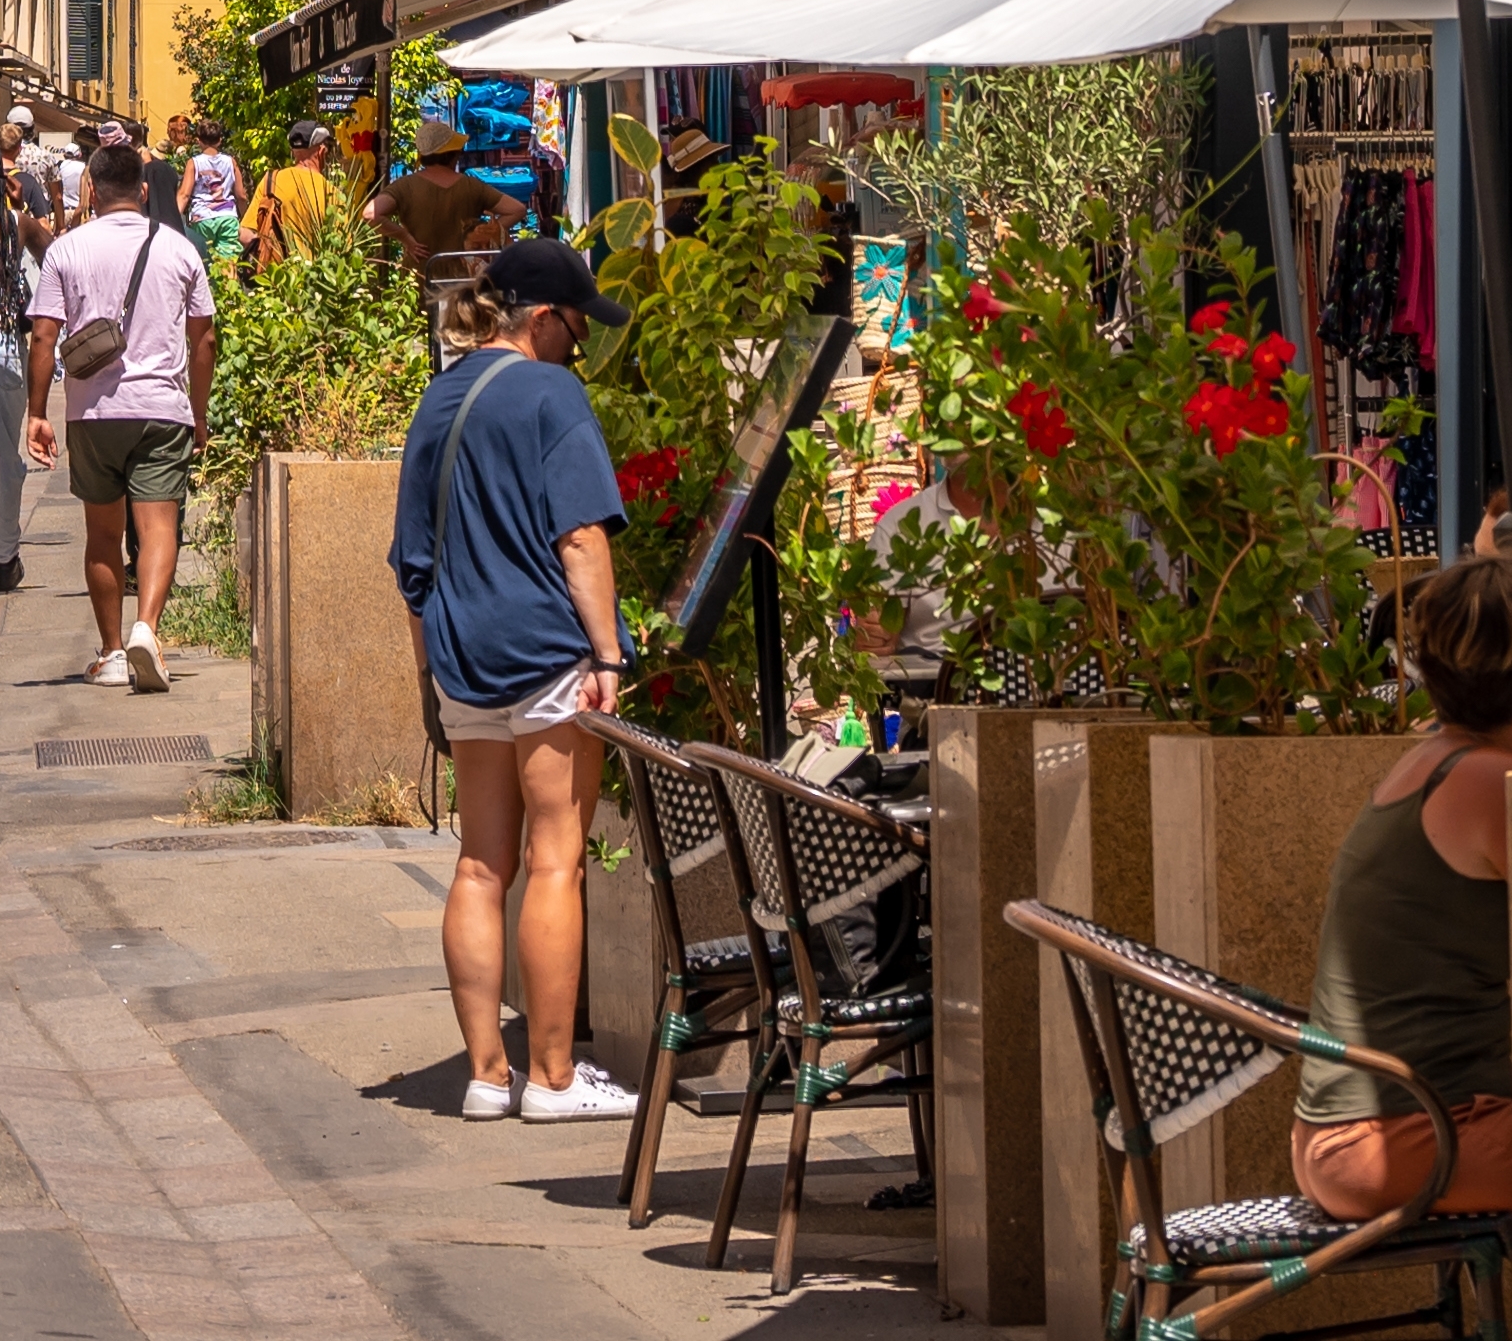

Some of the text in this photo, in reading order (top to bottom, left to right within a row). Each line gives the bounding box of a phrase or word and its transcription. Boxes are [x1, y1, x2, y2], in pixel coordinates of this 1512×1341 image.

[341, 64, 351, 73] de
[317, 74, 373, 86] Nicolas Joyeux
